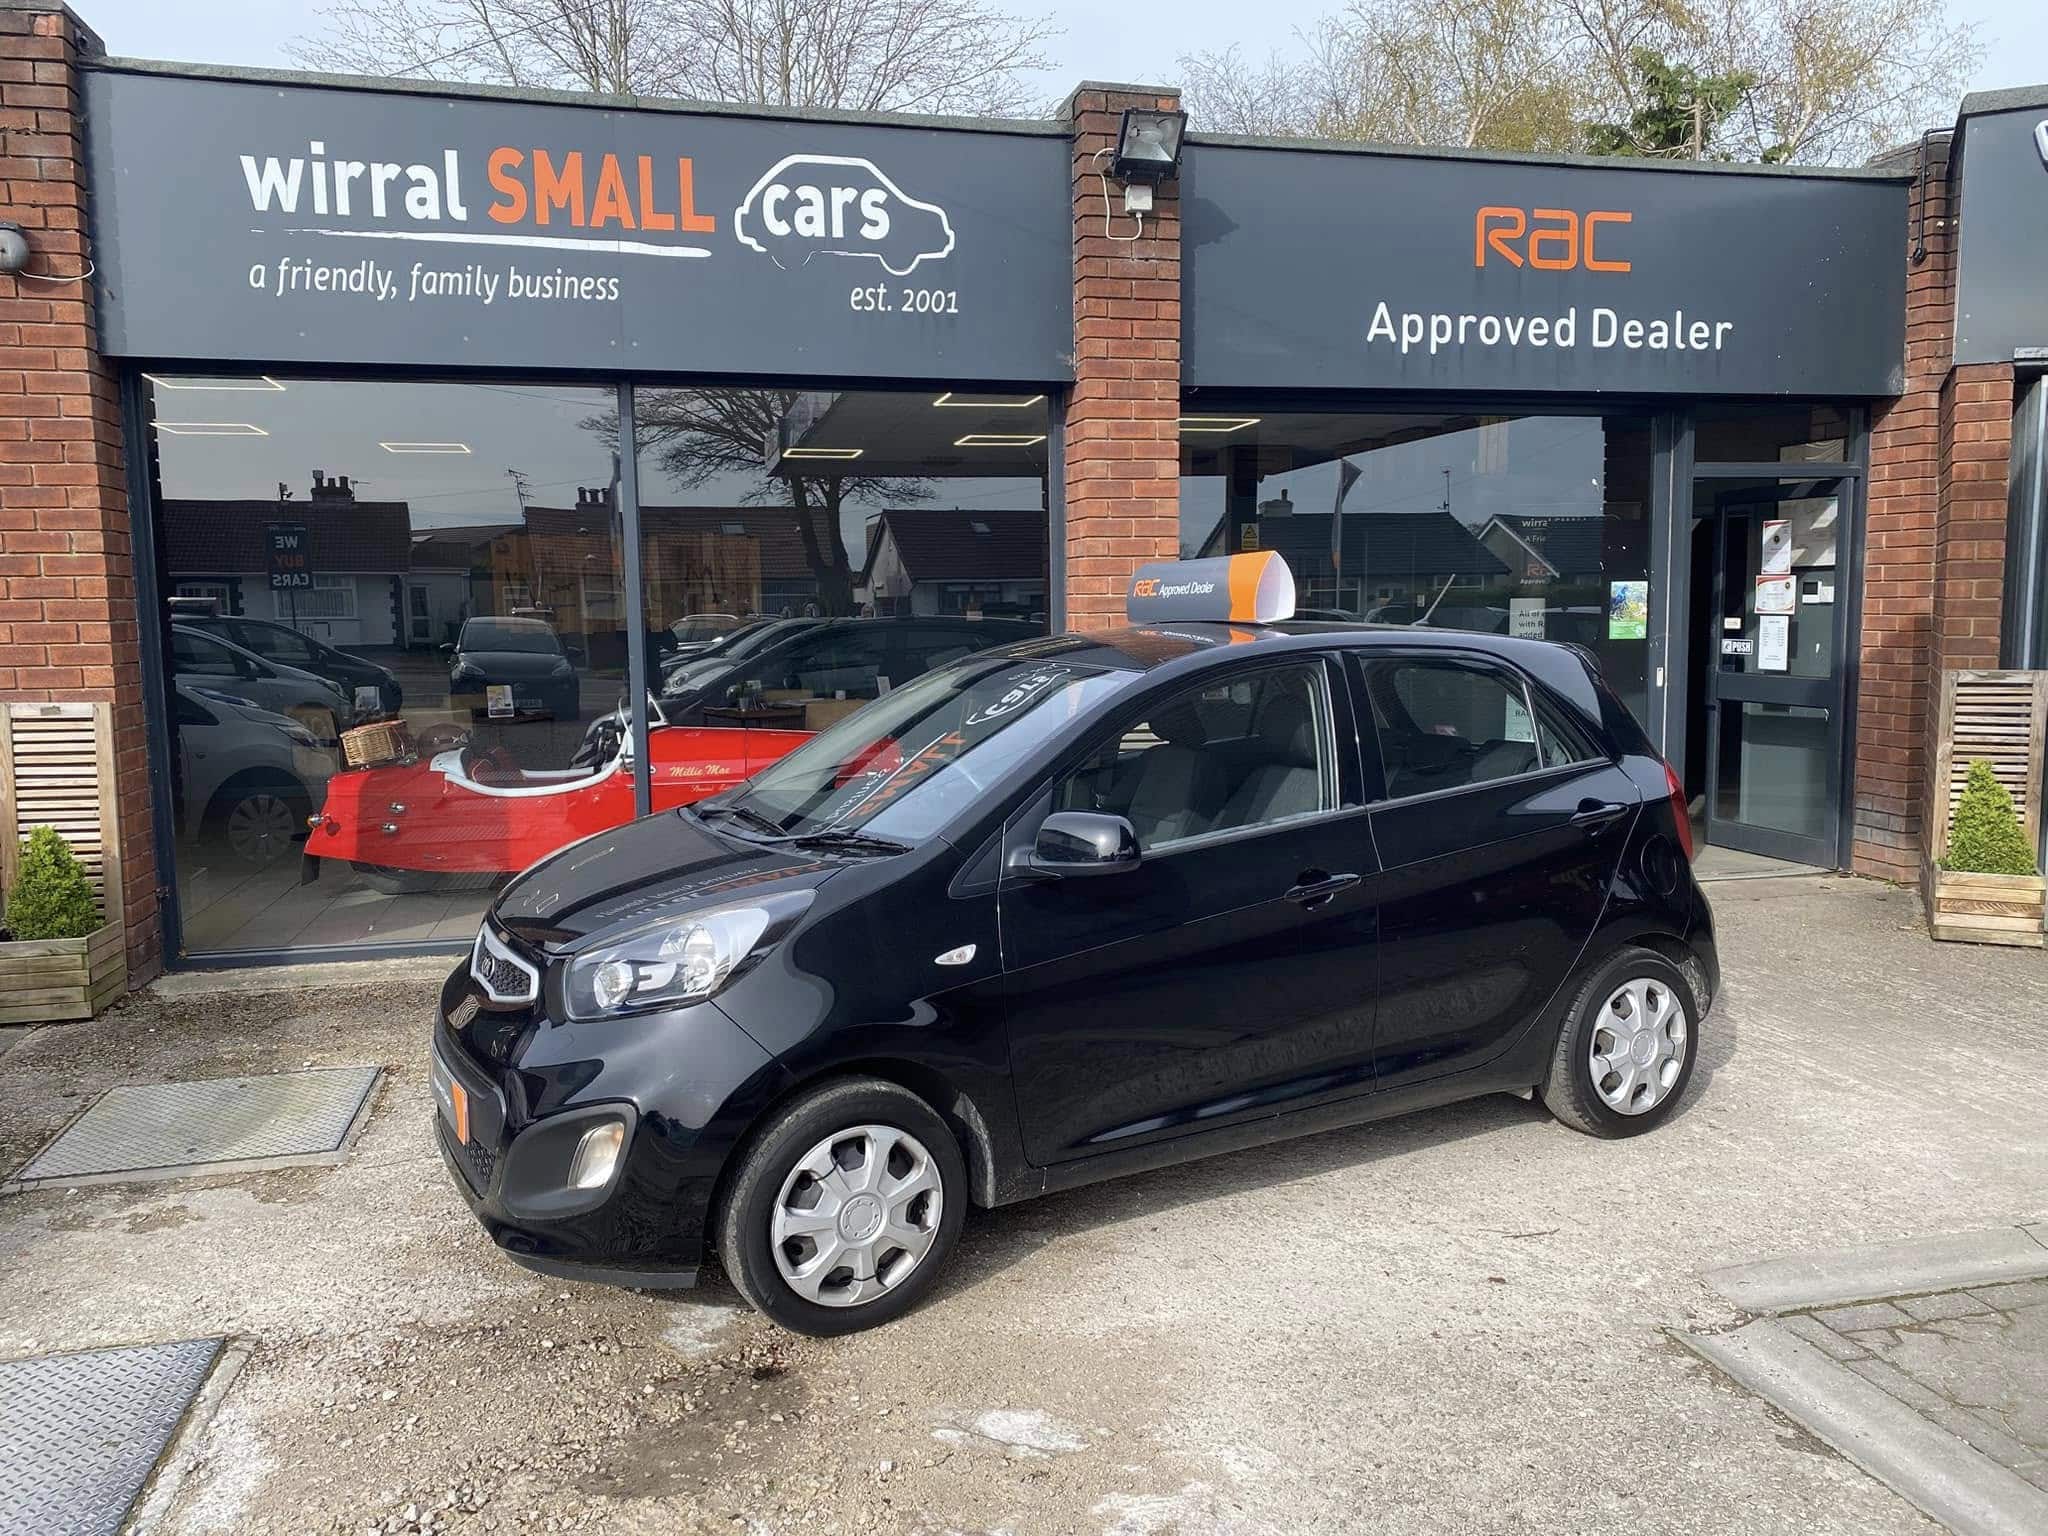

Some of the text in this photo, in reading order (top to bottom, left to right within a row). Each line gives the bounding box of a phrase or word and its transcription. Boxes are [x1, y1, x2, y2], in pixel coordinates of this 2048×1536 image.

[239, 140, 891, 240] wirral SMALL cars
[1475, 206, 1632, 273] RAC
[249, 256, 619, 305] a friendly, family business
[850, 282, 959, 314] est. 2001
[1366, 301, 1733, 355] Approved Dealer
[1159, 582, 1191, 599] Approved
[1191, 581, 1215, 594] Dealer
[1732, 641, 1751, 653] PUSH
